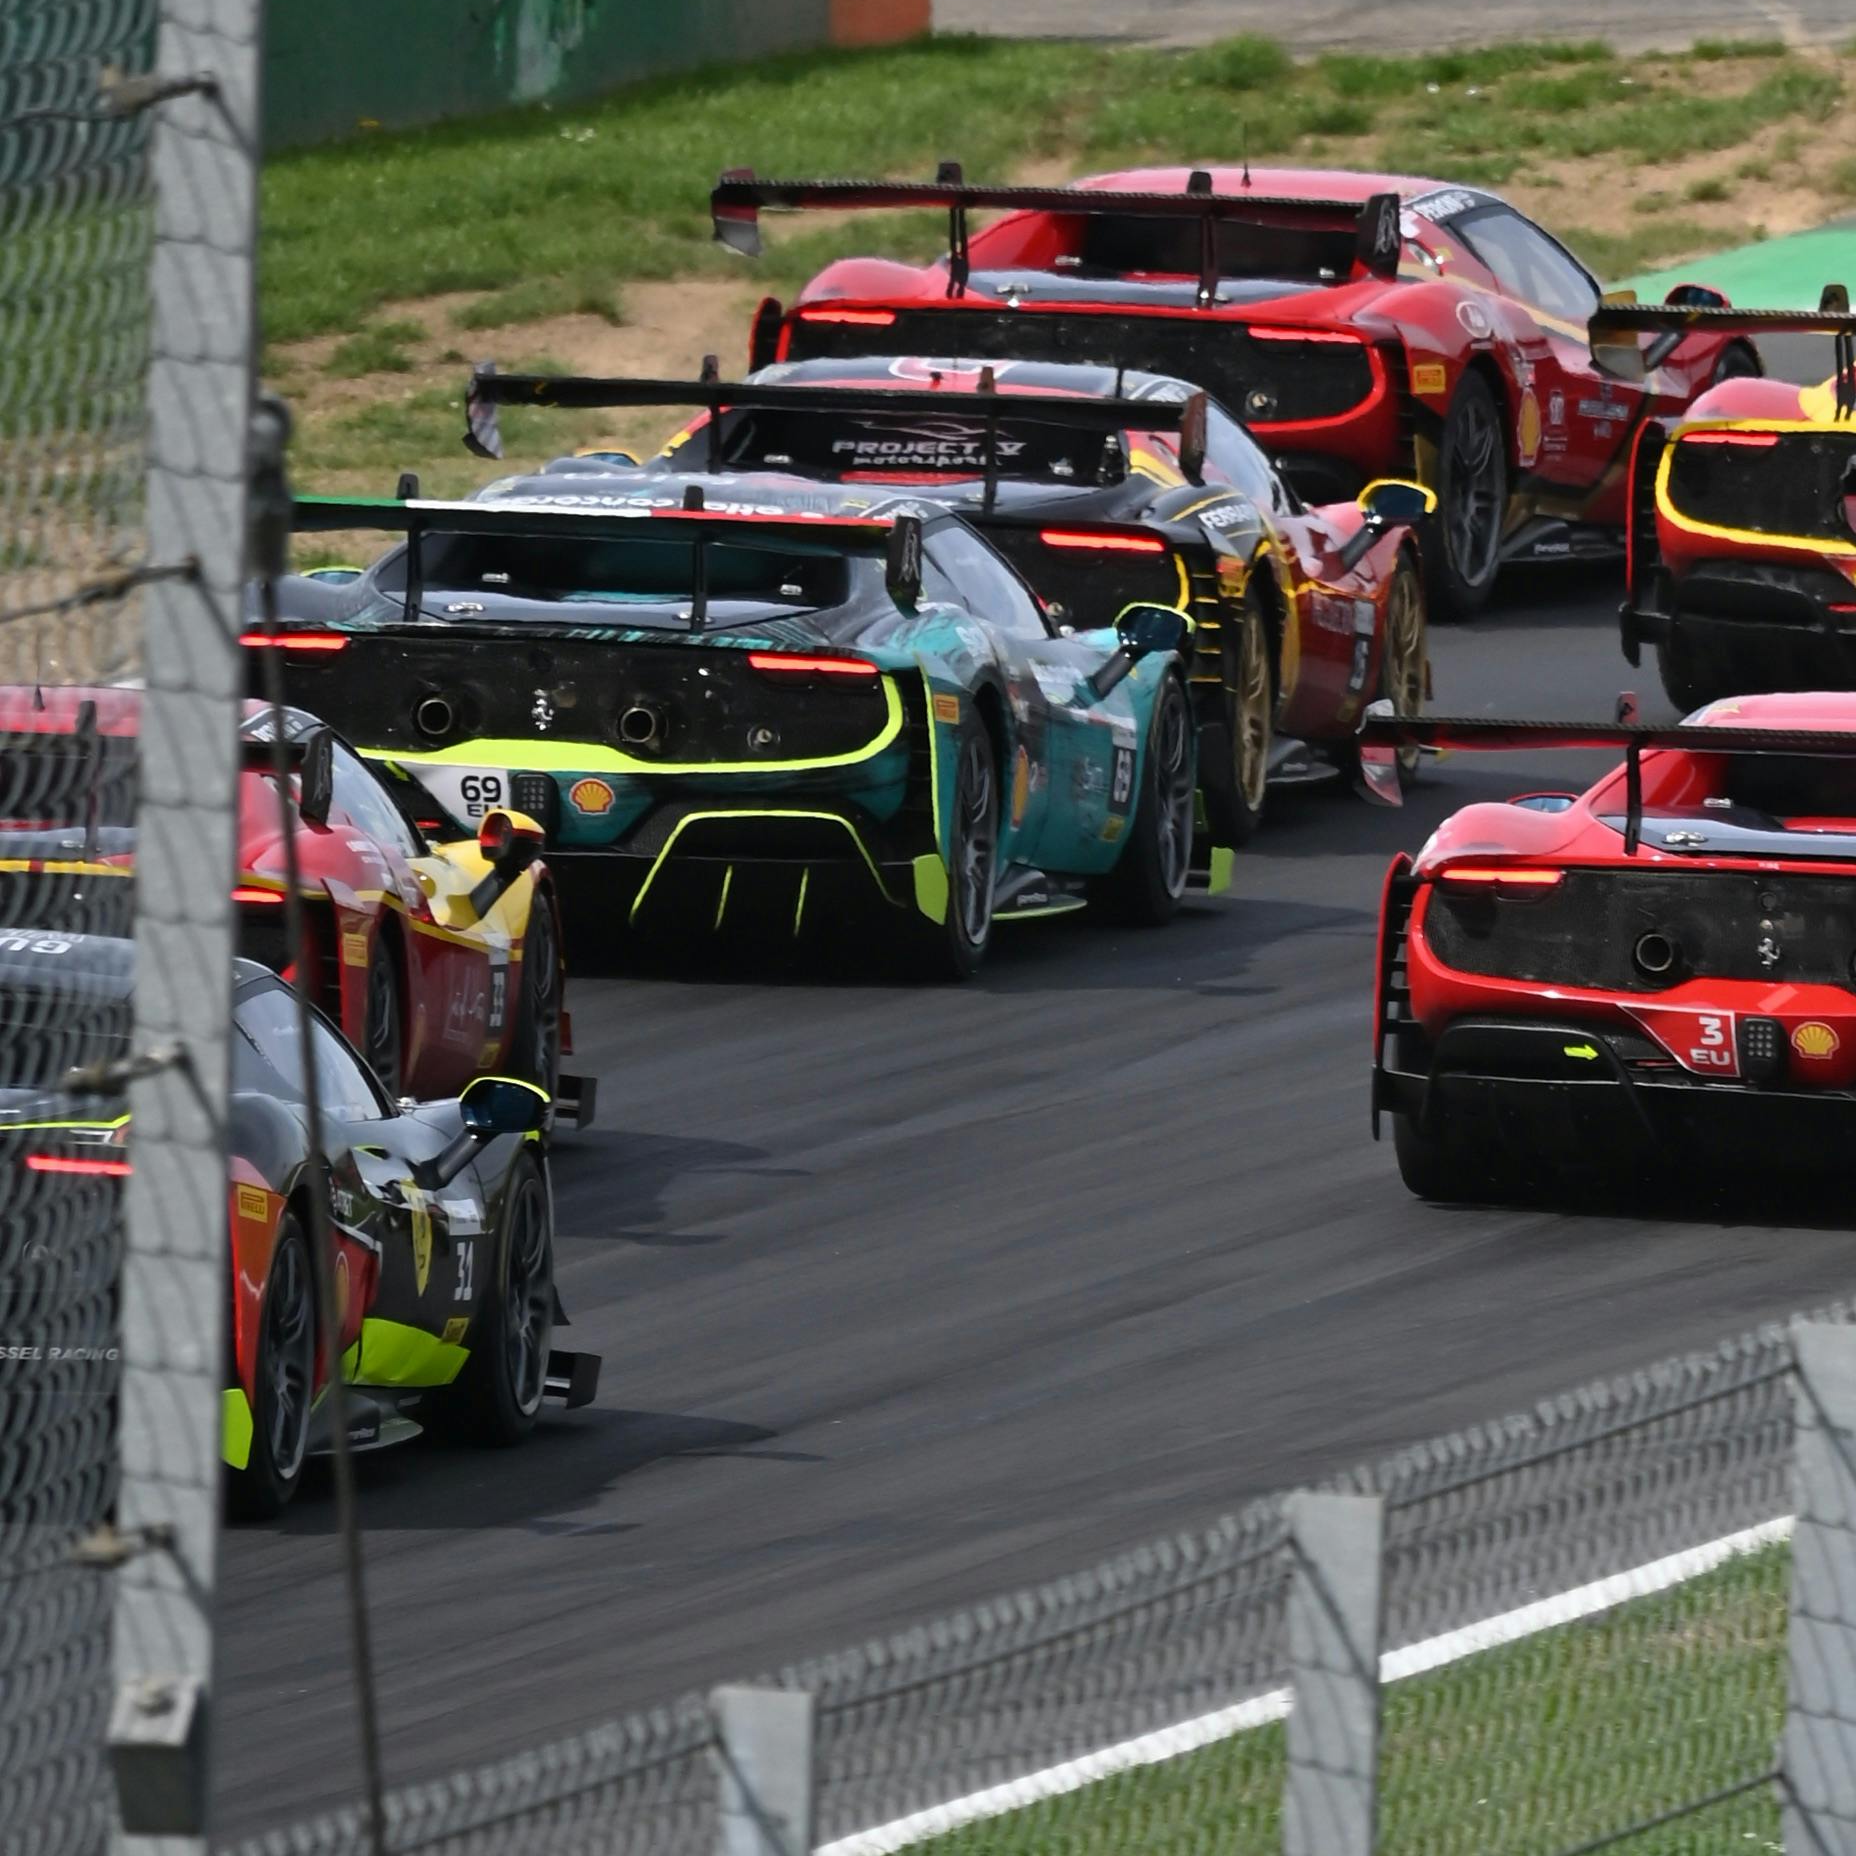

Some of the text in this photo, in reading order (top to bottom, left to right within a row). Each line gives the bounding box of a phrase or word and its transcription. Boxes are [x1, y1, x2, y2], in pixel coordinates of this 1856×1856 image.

[832, 440, 980, 455] PROJECT
[460, 774, 501, 803] 69
[1698, 1016, 1724, 1046] 3
[1690, 1048, 1731, 1066] EU
[453, 1241, 474, 1301] 31
[48, 1347, 120, 1361] RACING
